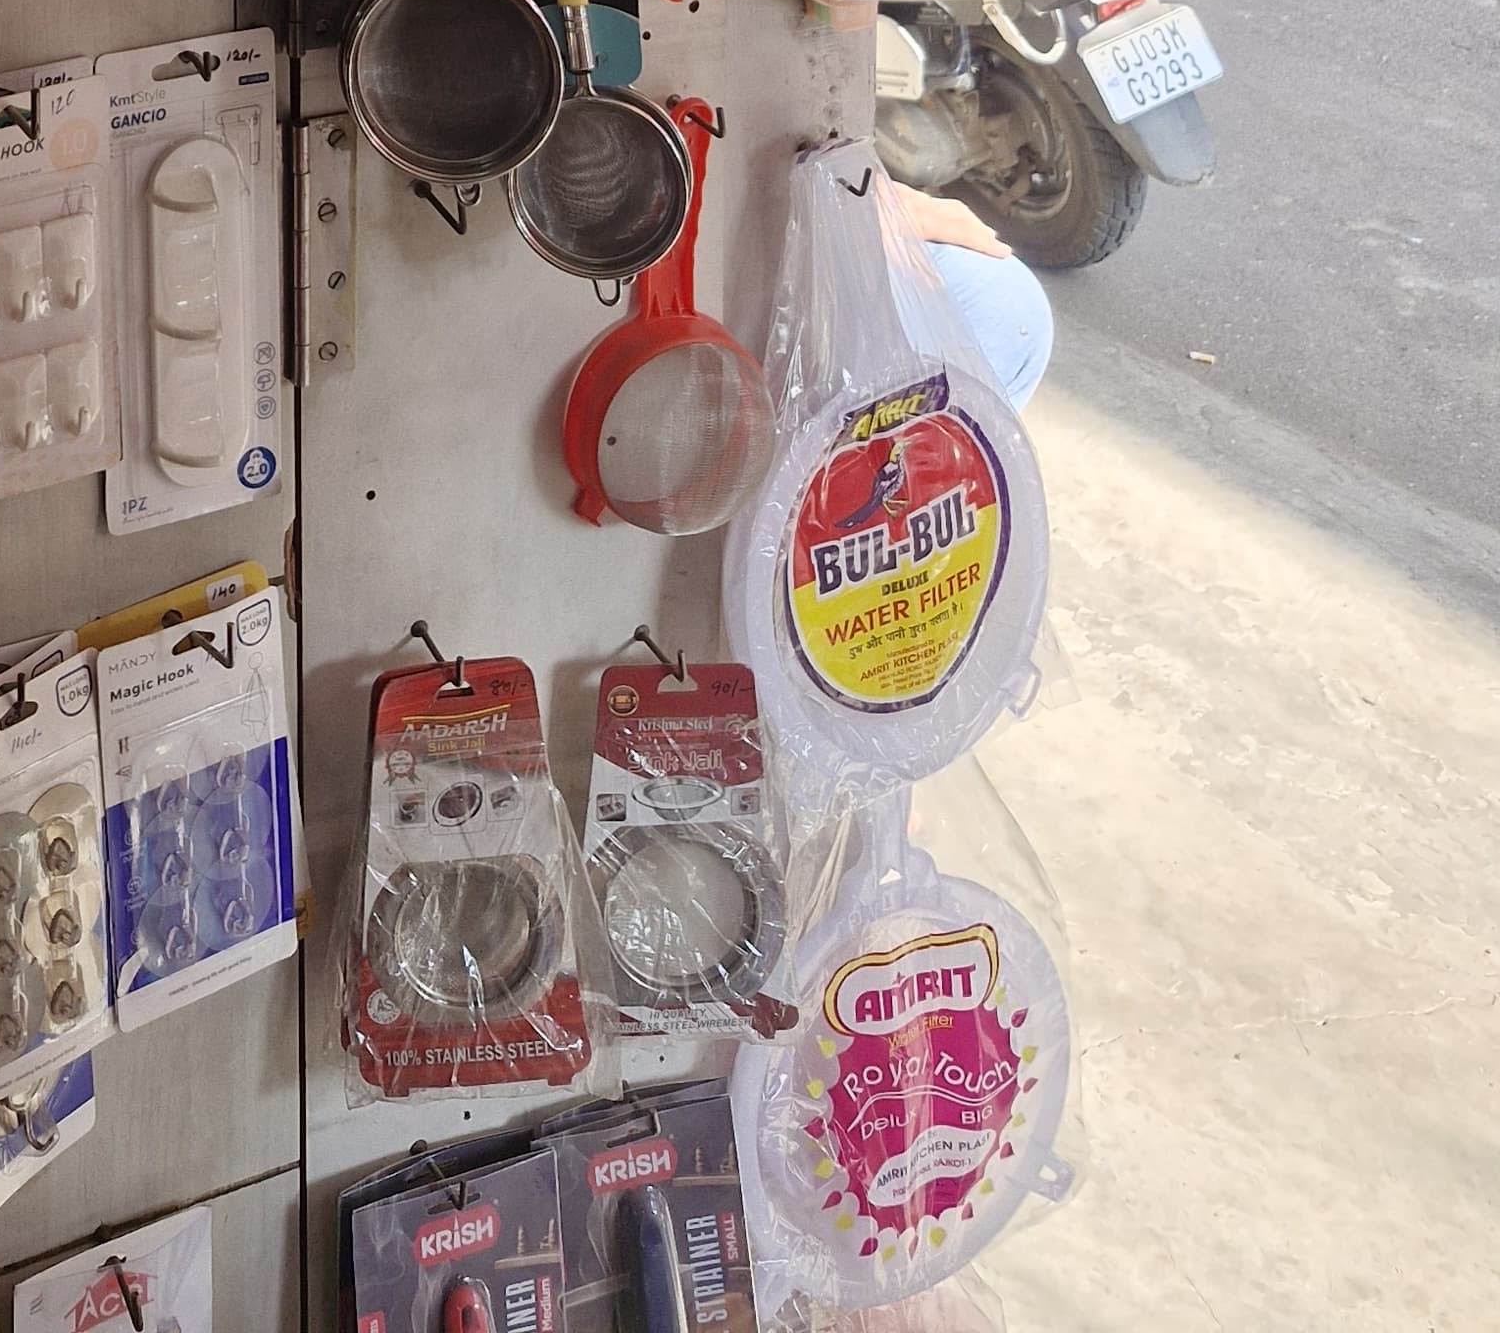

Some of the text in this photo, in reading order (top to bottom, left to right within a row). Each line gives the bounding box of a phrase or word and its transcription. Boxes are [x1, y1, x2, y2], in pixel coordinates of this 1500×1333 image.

[110, 108, 167, 129] GANCIO
[0, 137, 45, 160] HOOK
[851, 390, 929, 442] AMRIT
[247, 462, 268, 478] 2.0
[813, 488, 978, 596] BUL-BUL
[881, 570, 930, 597] DELUXE
[824, 562, 981, 646] WATER FILTER
[894, 646, 936, 668] KITCHEN
[109, 679, 155, 702] Magic
[157, 663, 195, 686] Hook
[400, 711, 508, 743] AADARSH
[427, 737, 486, 753] Sink Jali
[680, 749, 724, 772] Jali
[855, 964, 976, 1025] AMRIT
[384, 1040, 553, 1067] 100% STAINLESS STEEL
[843, 1049, 1014, 1103] Royal Touch
[960, 1104, 994, 1126] BIG
[593, 1147, 671, 1187] KRISH
[420, 1216, 495, 1257] KRISH
[727, 1216, 739, 1259] SMALL
[685, 1213, 728, 1324] STRAINER
[539, 1276, 552, 1331] Medium
